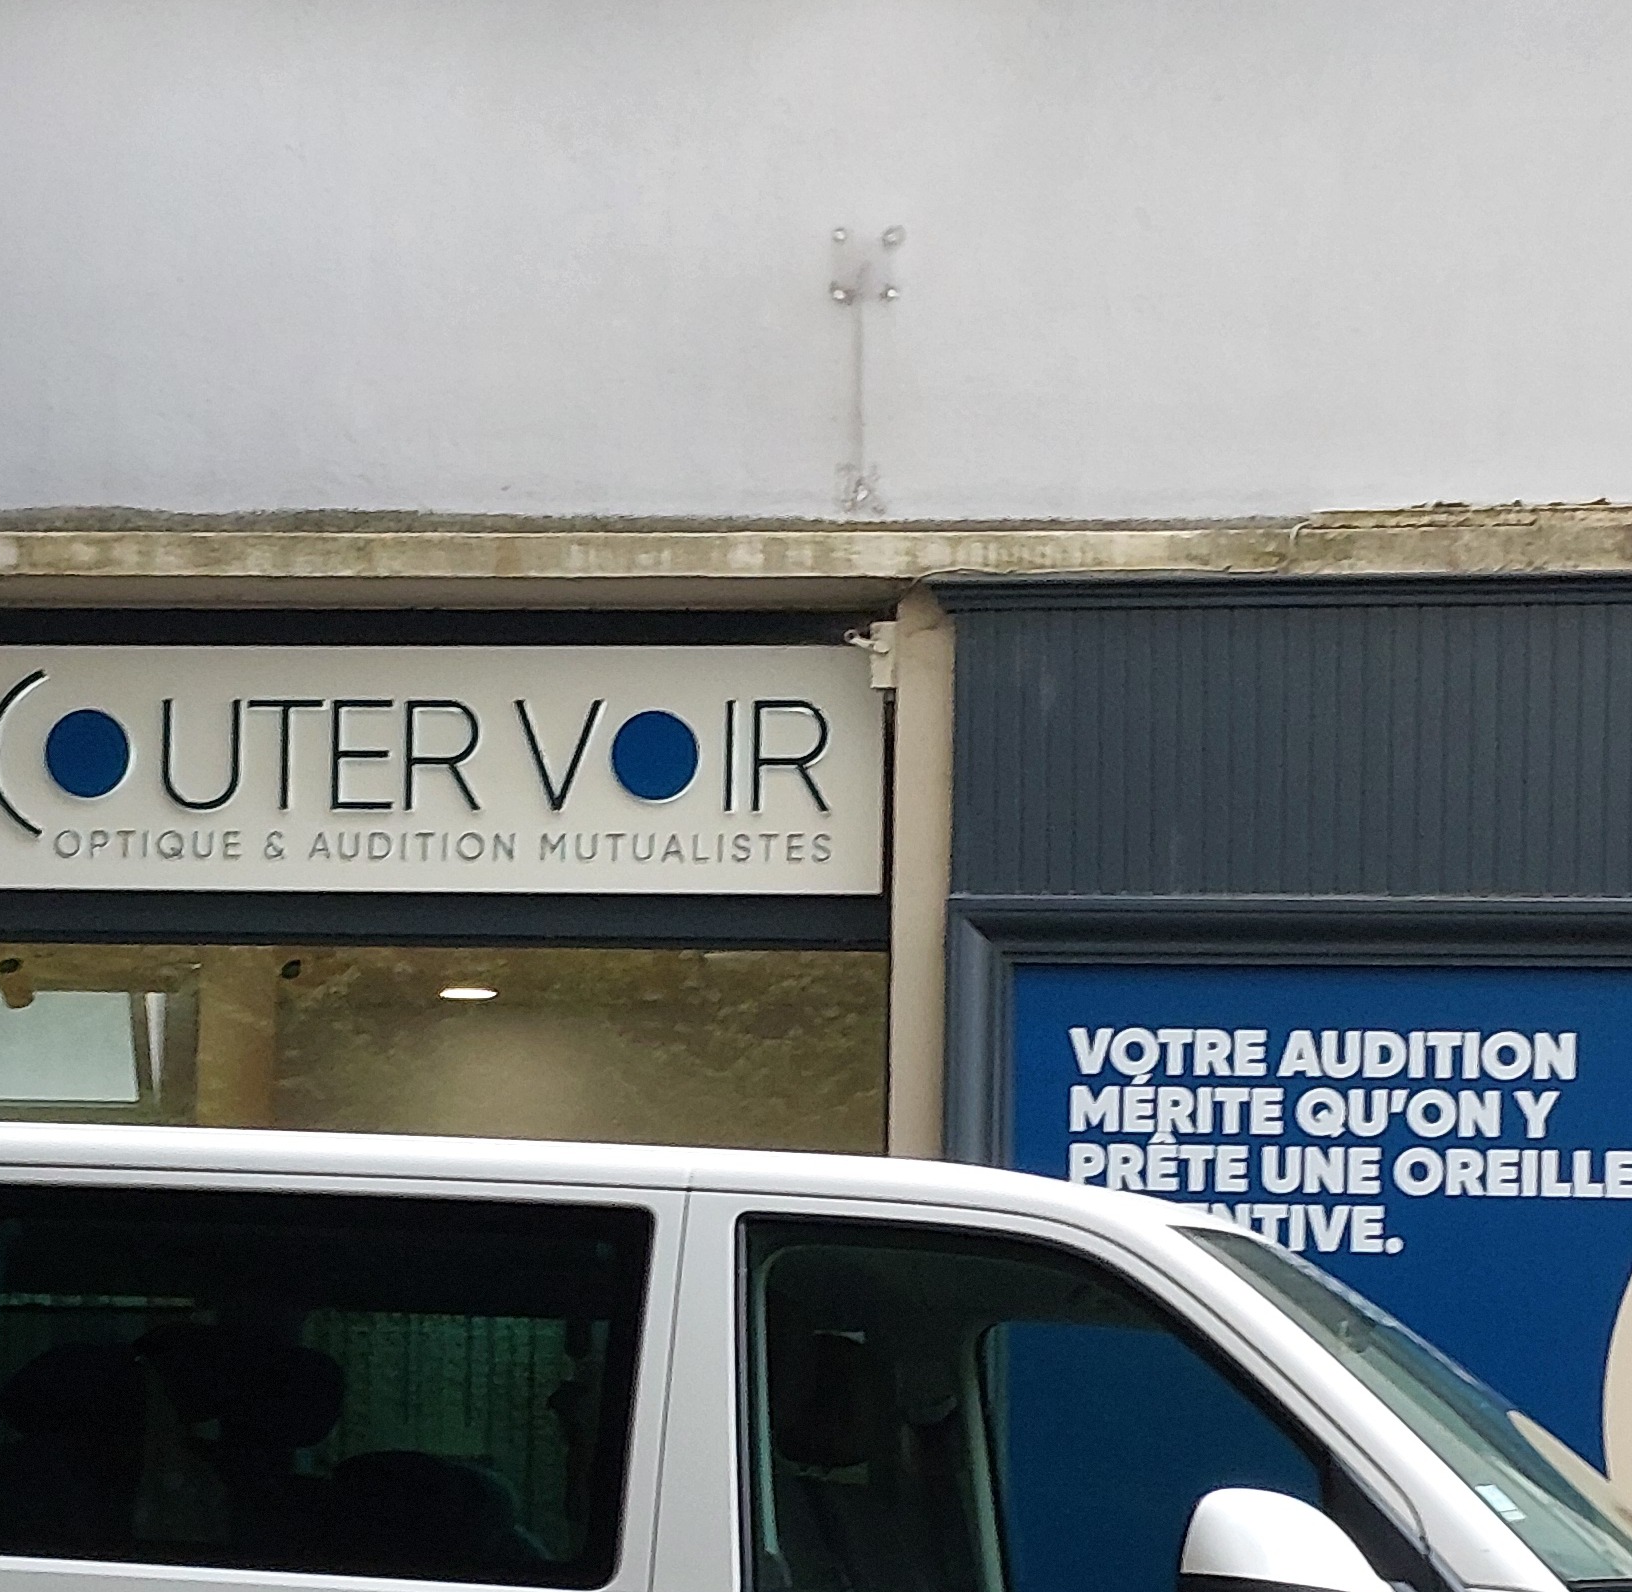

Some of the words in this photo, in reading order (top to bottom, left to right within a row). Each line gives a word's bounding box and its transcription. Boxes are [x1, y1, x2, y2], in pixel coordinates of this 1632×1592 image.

[514, 698, 832, 815] VOIR
[52, 829, 244, 864] OPTIQUE
[263, 829, 287, 862] &
[306, 828, 516, 863] AUDITION
[538, 828, 833, 864] MUTUALISTES
[1068, 1028, 1267, 1077] VOTRE
[1276, 1030, 1578, 1080] AUDITION
[1068, 1074, 1284, 1137] MÉRITE
[1296, 1087, 1500, 1139] QU'ON
[1513, 1090, 1560, 1139] Y
[1068, 1133, 1249, 1192] PRÊTE
[1261, 1145, 1381, 1195] UNE
